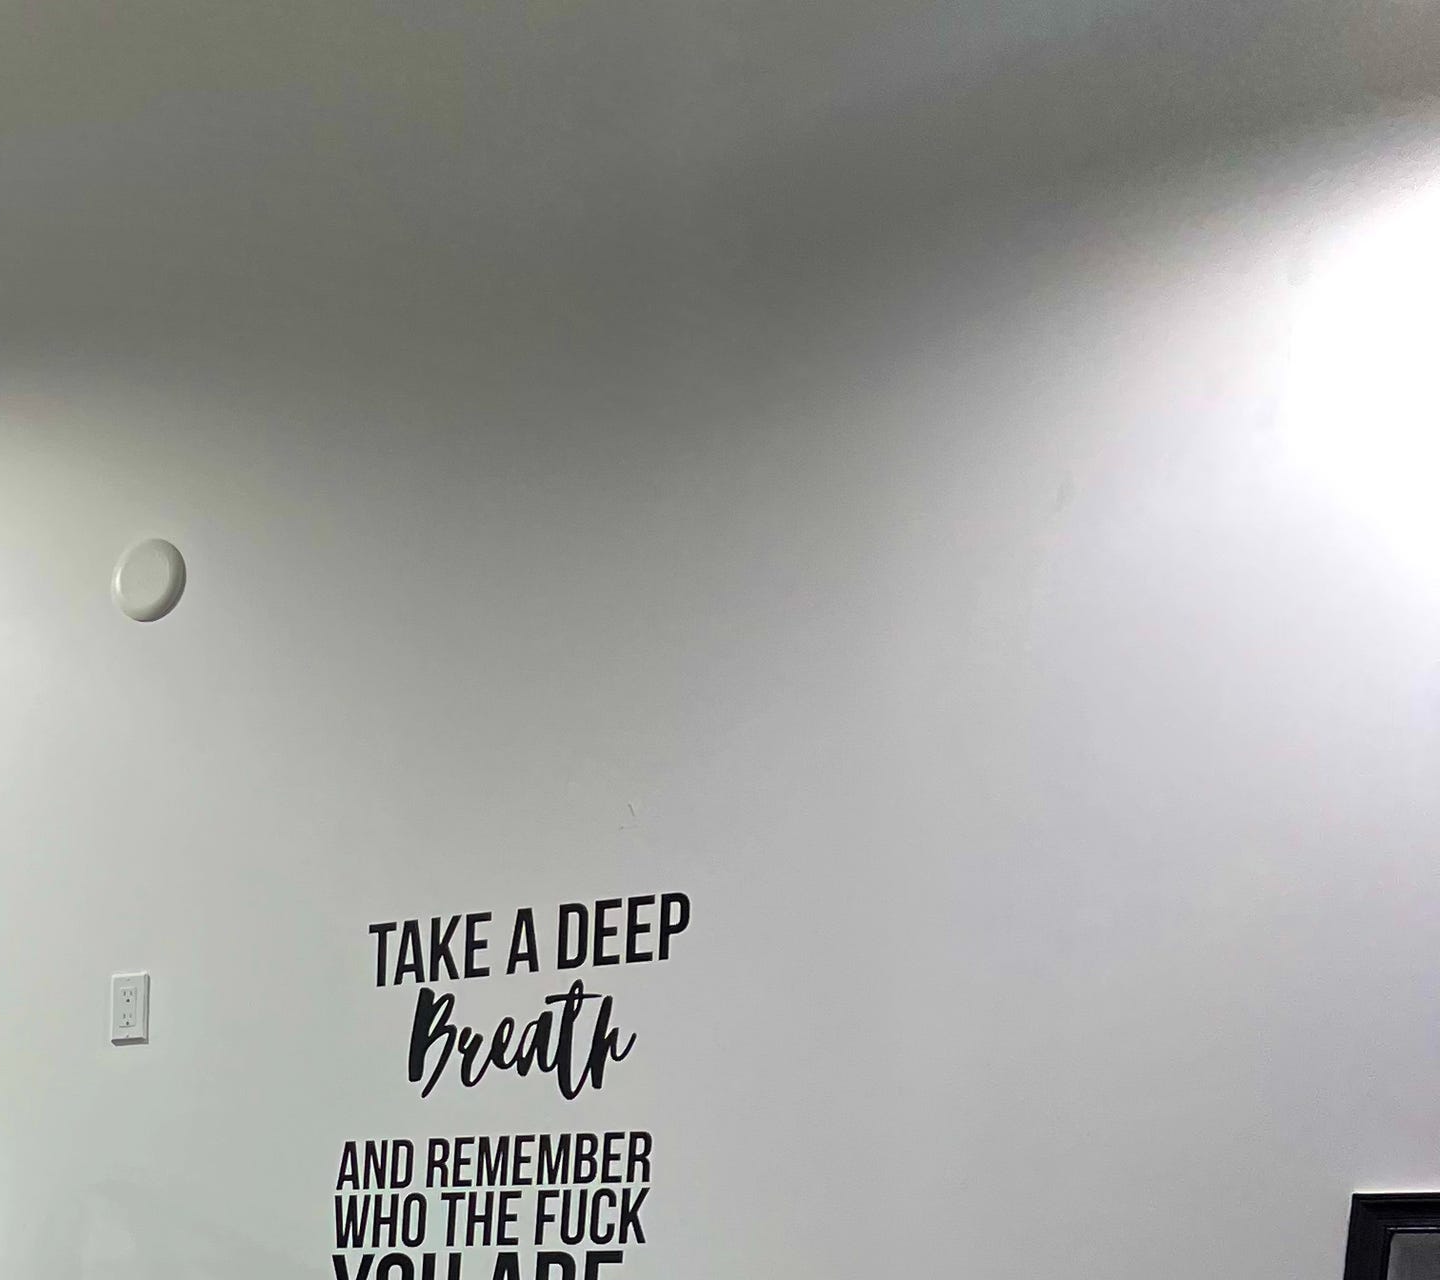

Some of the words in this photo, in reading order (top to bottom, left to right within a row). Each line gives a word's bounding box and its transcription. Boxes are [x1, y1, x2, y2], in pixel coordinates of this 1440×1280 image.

[368, 911, 492, 987] TAKE
[506, 907, 539, 975] A
[557, 892, 691, 970] DEEP
[408, 978, 637, 1101] Breath
[335, 1139, 414, 1191] AND
[425, 1131, 653, 1188] REMEMBER
[335, 1192, 427, 1249] WHO
[440, 1190, 522, 1247] THE
[534, 1187, 651, 1246] FUCK
